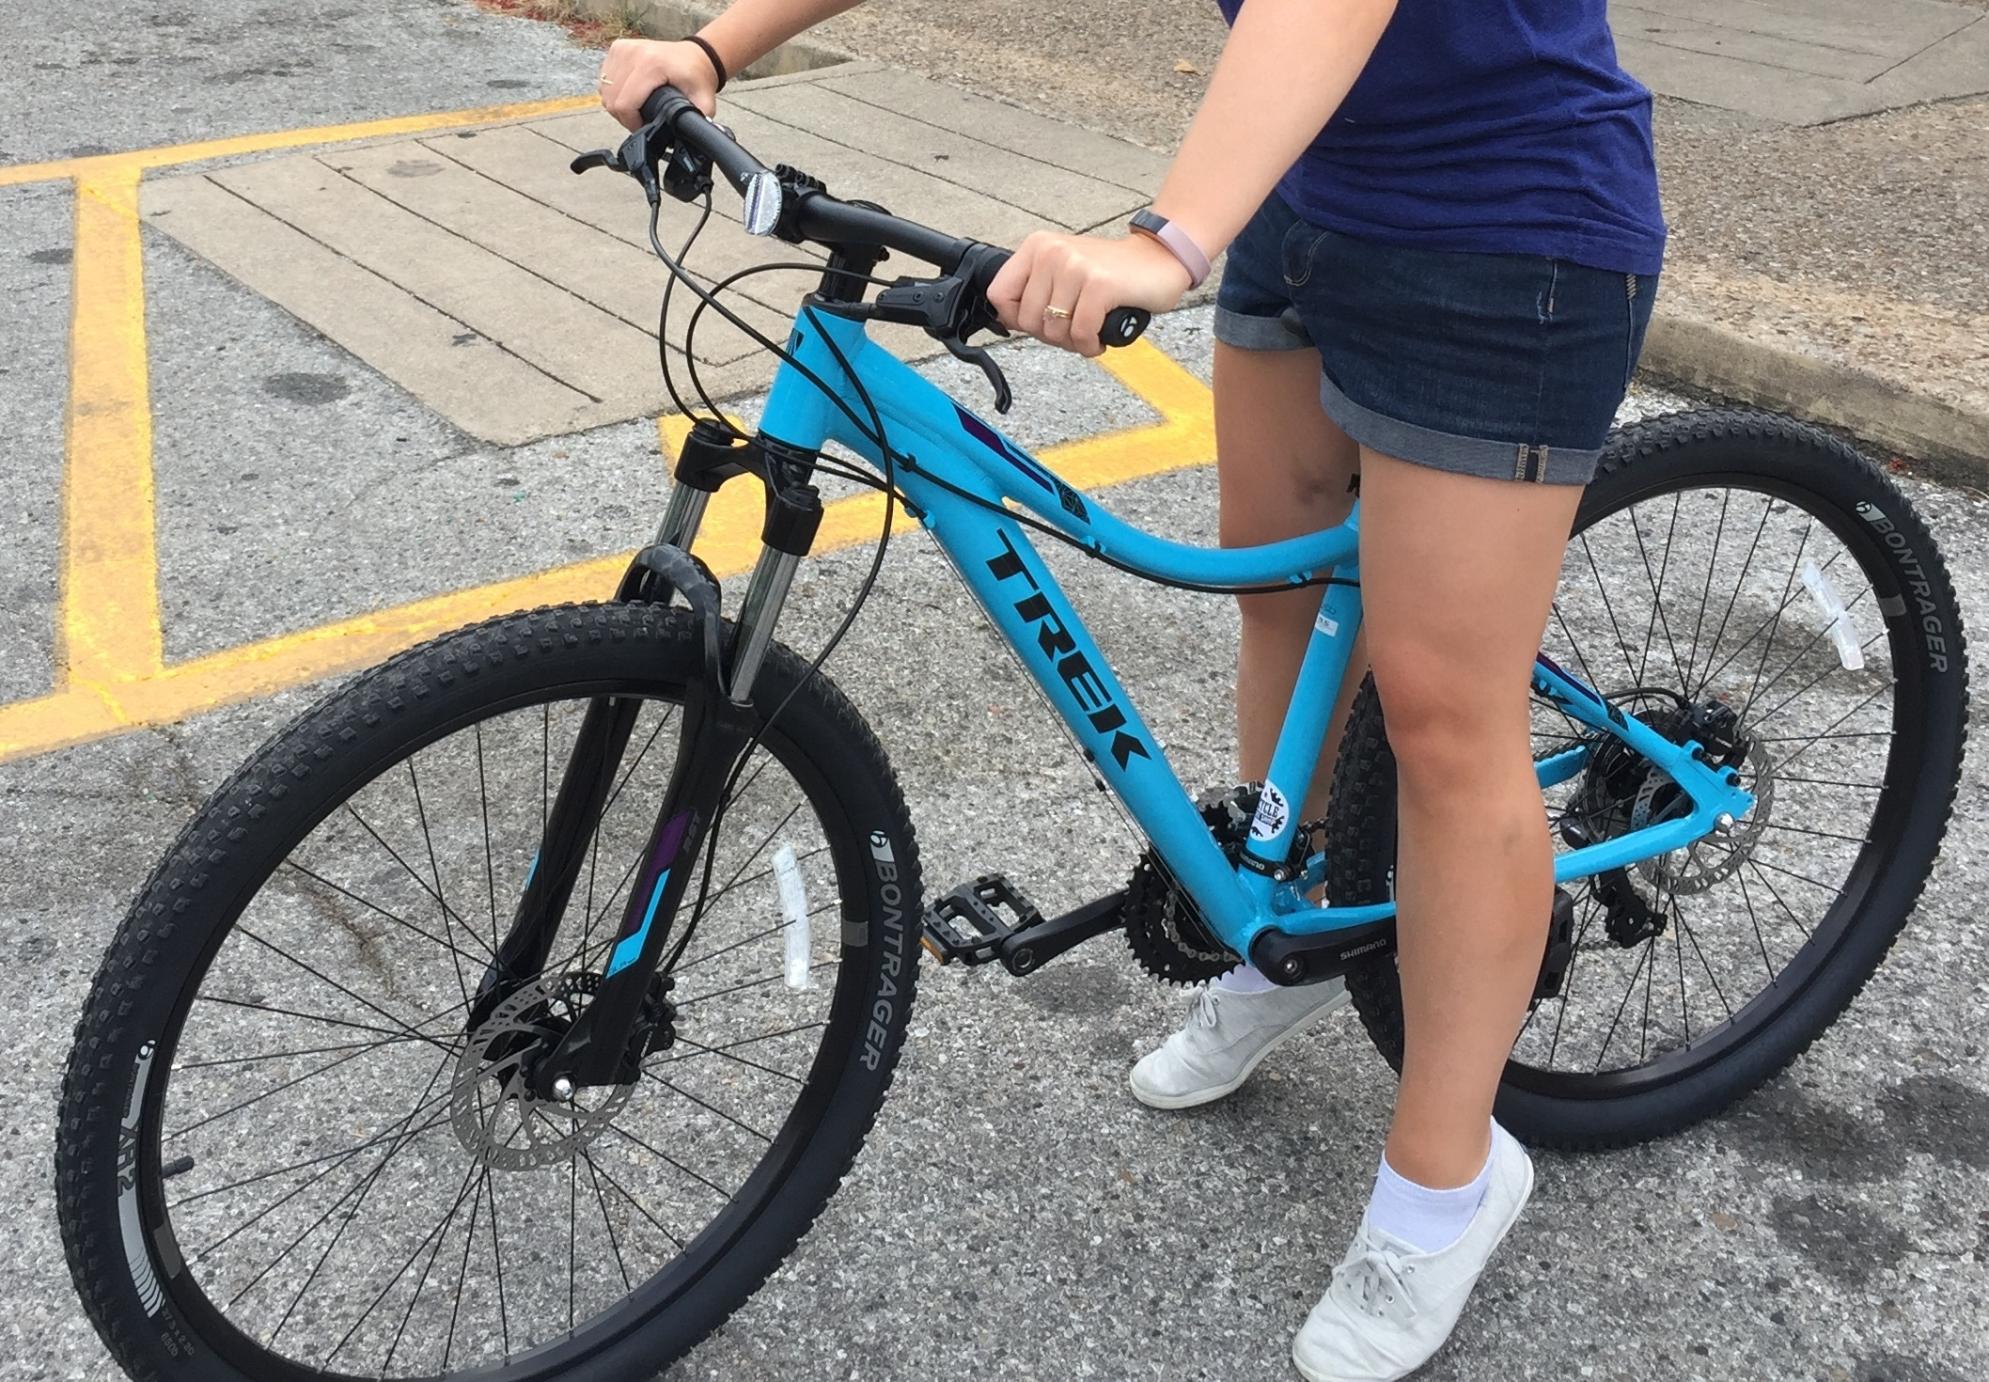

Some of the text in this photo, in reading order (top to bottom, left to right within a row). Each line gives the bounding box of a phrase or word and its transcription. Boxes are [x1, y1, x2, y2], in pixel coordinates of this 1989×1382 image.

[985, 527, 1152, 772] TREK
[1871, 518, 1948, 673] BONTRAGER
[1257, 799, 1280, 818] YCLE
[859, 862, 904, 1072] BONTRAGER
[1340, 938, 1387, 961] SHIMANO
